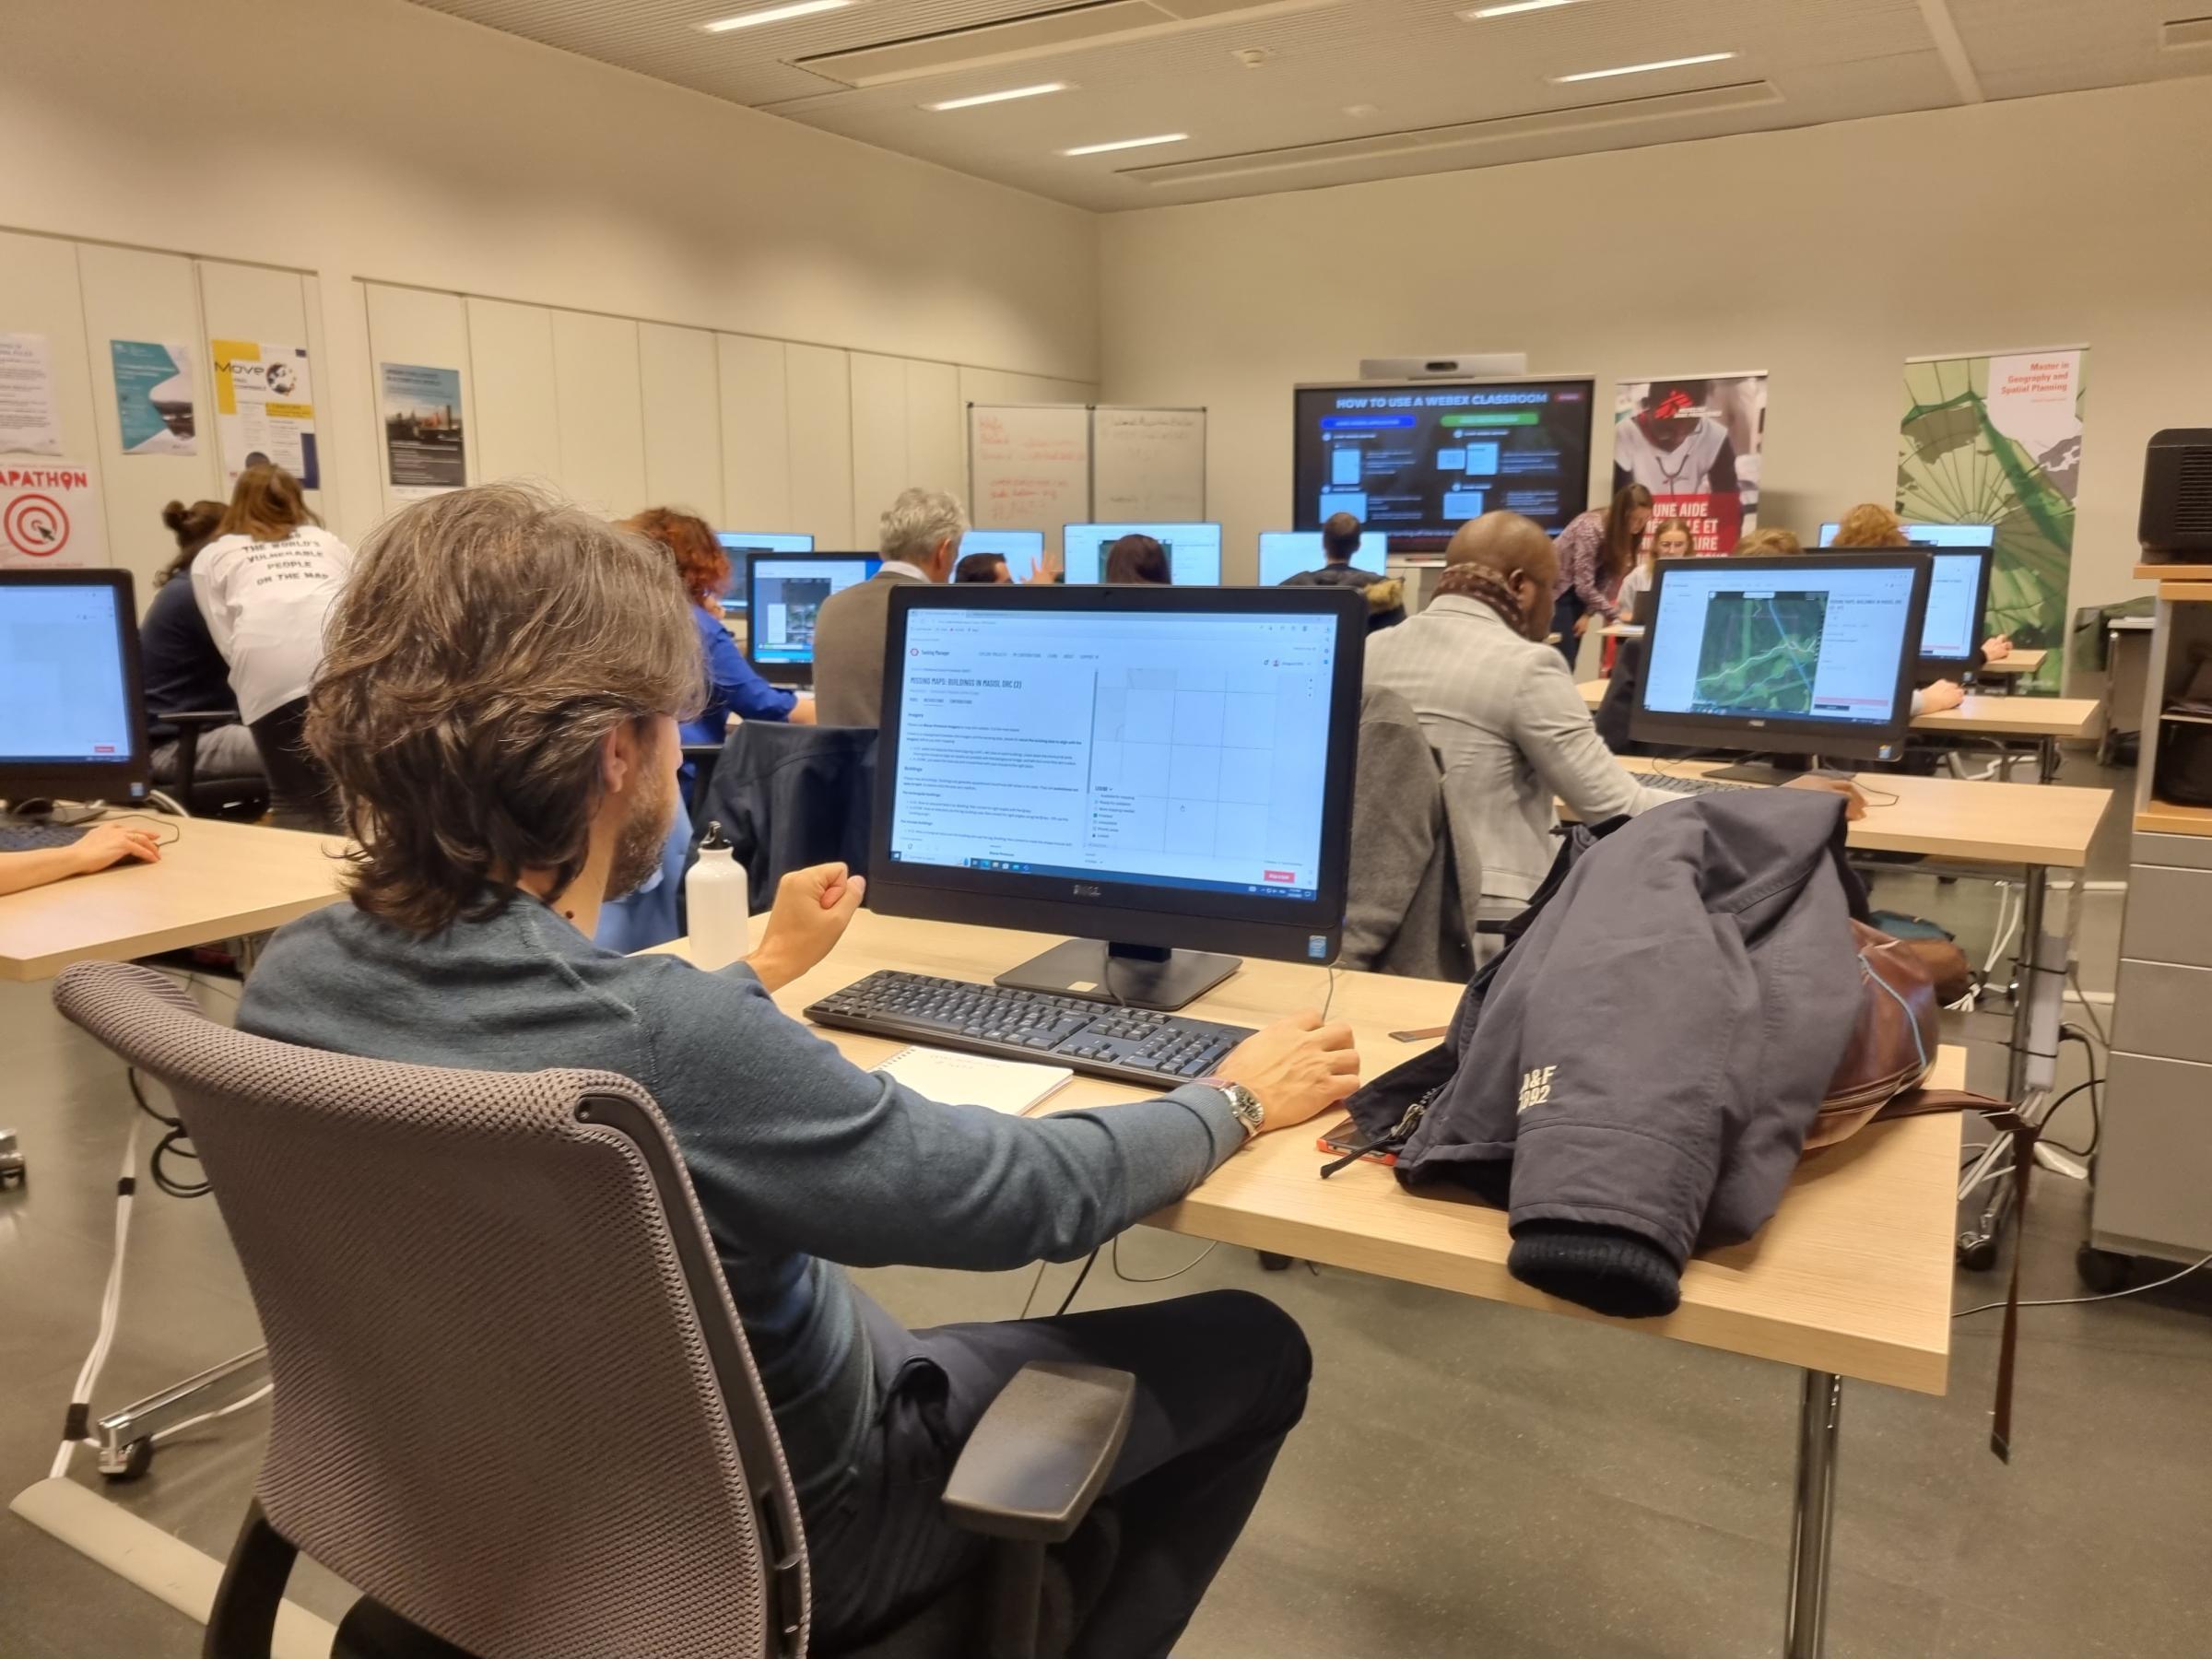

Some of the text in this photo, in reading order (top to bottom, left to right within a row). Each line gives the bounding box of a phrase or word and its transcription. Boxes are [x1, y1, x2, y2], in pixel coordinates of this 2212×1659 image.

[214, 360, 265, 375] Move
[2030, 362, 2059, 371] Master
[2007, 371, 2068, 383] Geography and
[2001, 383, 2068, 395] Spatial Planning
[1336, 398, 1367, 408] HOW
[1370, 398, 1386, 407] TO
[1388, 396, 1412, 407] USE
[1412, 396, 1424, 406] A
[1425, 394, 1469, 406] WEBEX
[1472, 393, 1548, 406] CLASSROOM
[1652, 501, 1709, 517] UNE AIDE
[1702, 518, 1718, 534] ET
[256, 577, 273, 585] ON
